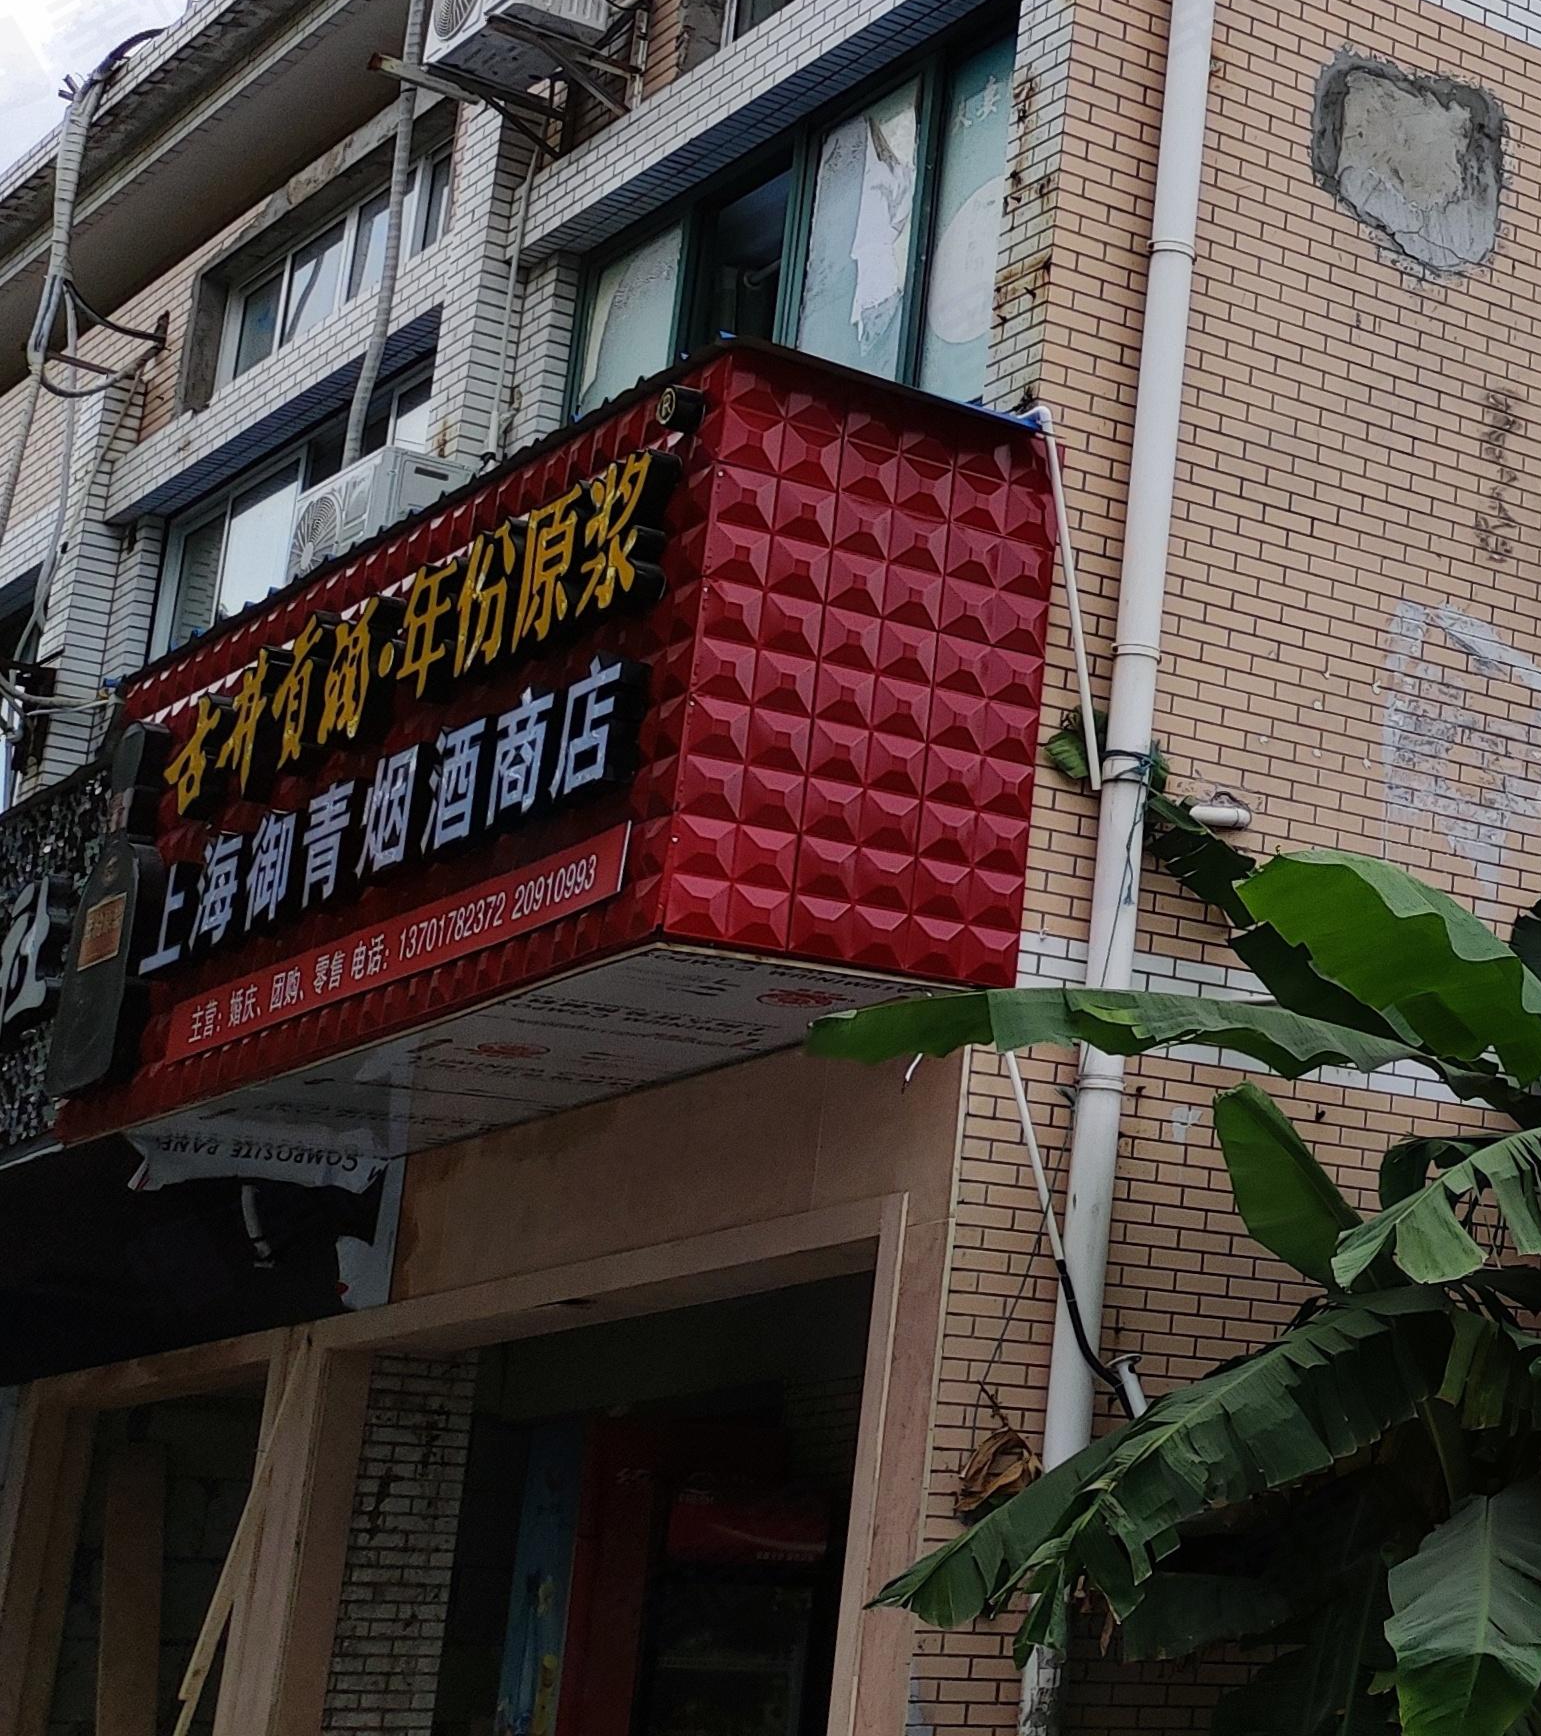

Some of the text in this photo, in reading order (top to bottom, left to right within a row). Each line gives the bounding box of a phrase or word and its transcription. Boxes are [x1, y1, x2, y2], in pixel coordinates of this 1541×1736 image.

[139, 656, 622, 976] 上海御青烟酒商店
[511, 854, 598, 921] 20910993
[231, 1141, 358, 1172] COMPOSITE
